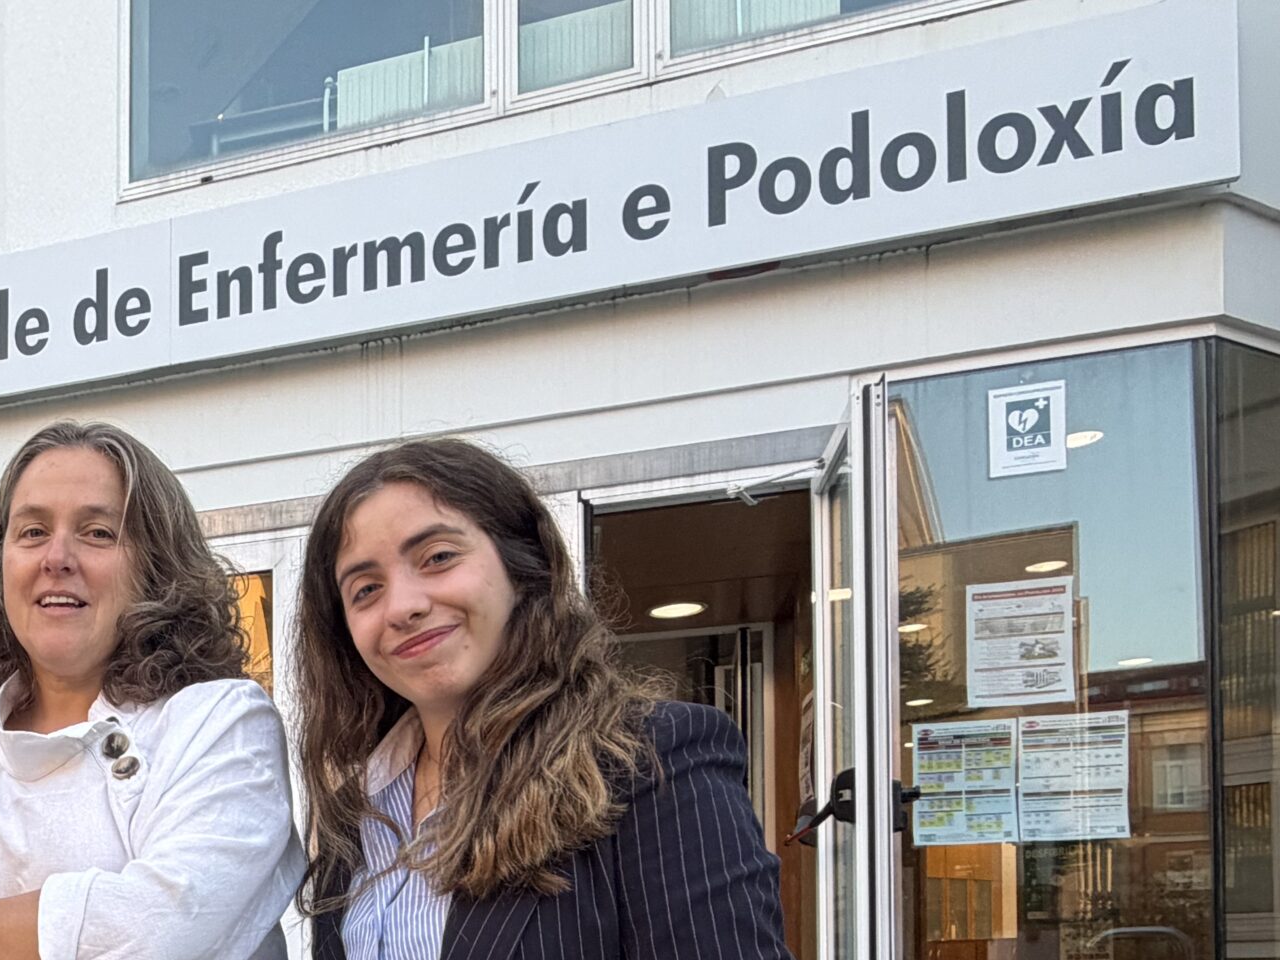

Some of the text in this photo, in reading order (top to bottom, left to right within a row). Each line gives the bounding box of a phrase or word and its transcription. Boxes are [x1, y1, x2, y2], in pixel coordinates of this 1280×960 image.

[73, 267, 151, 346] de
[178, 181, 588, 327] Enfermería
[622, 183, 671, 241] e
[707, 58, 1195, 228] Podoloxía
[1012, 434, 1046, 448] DEA
